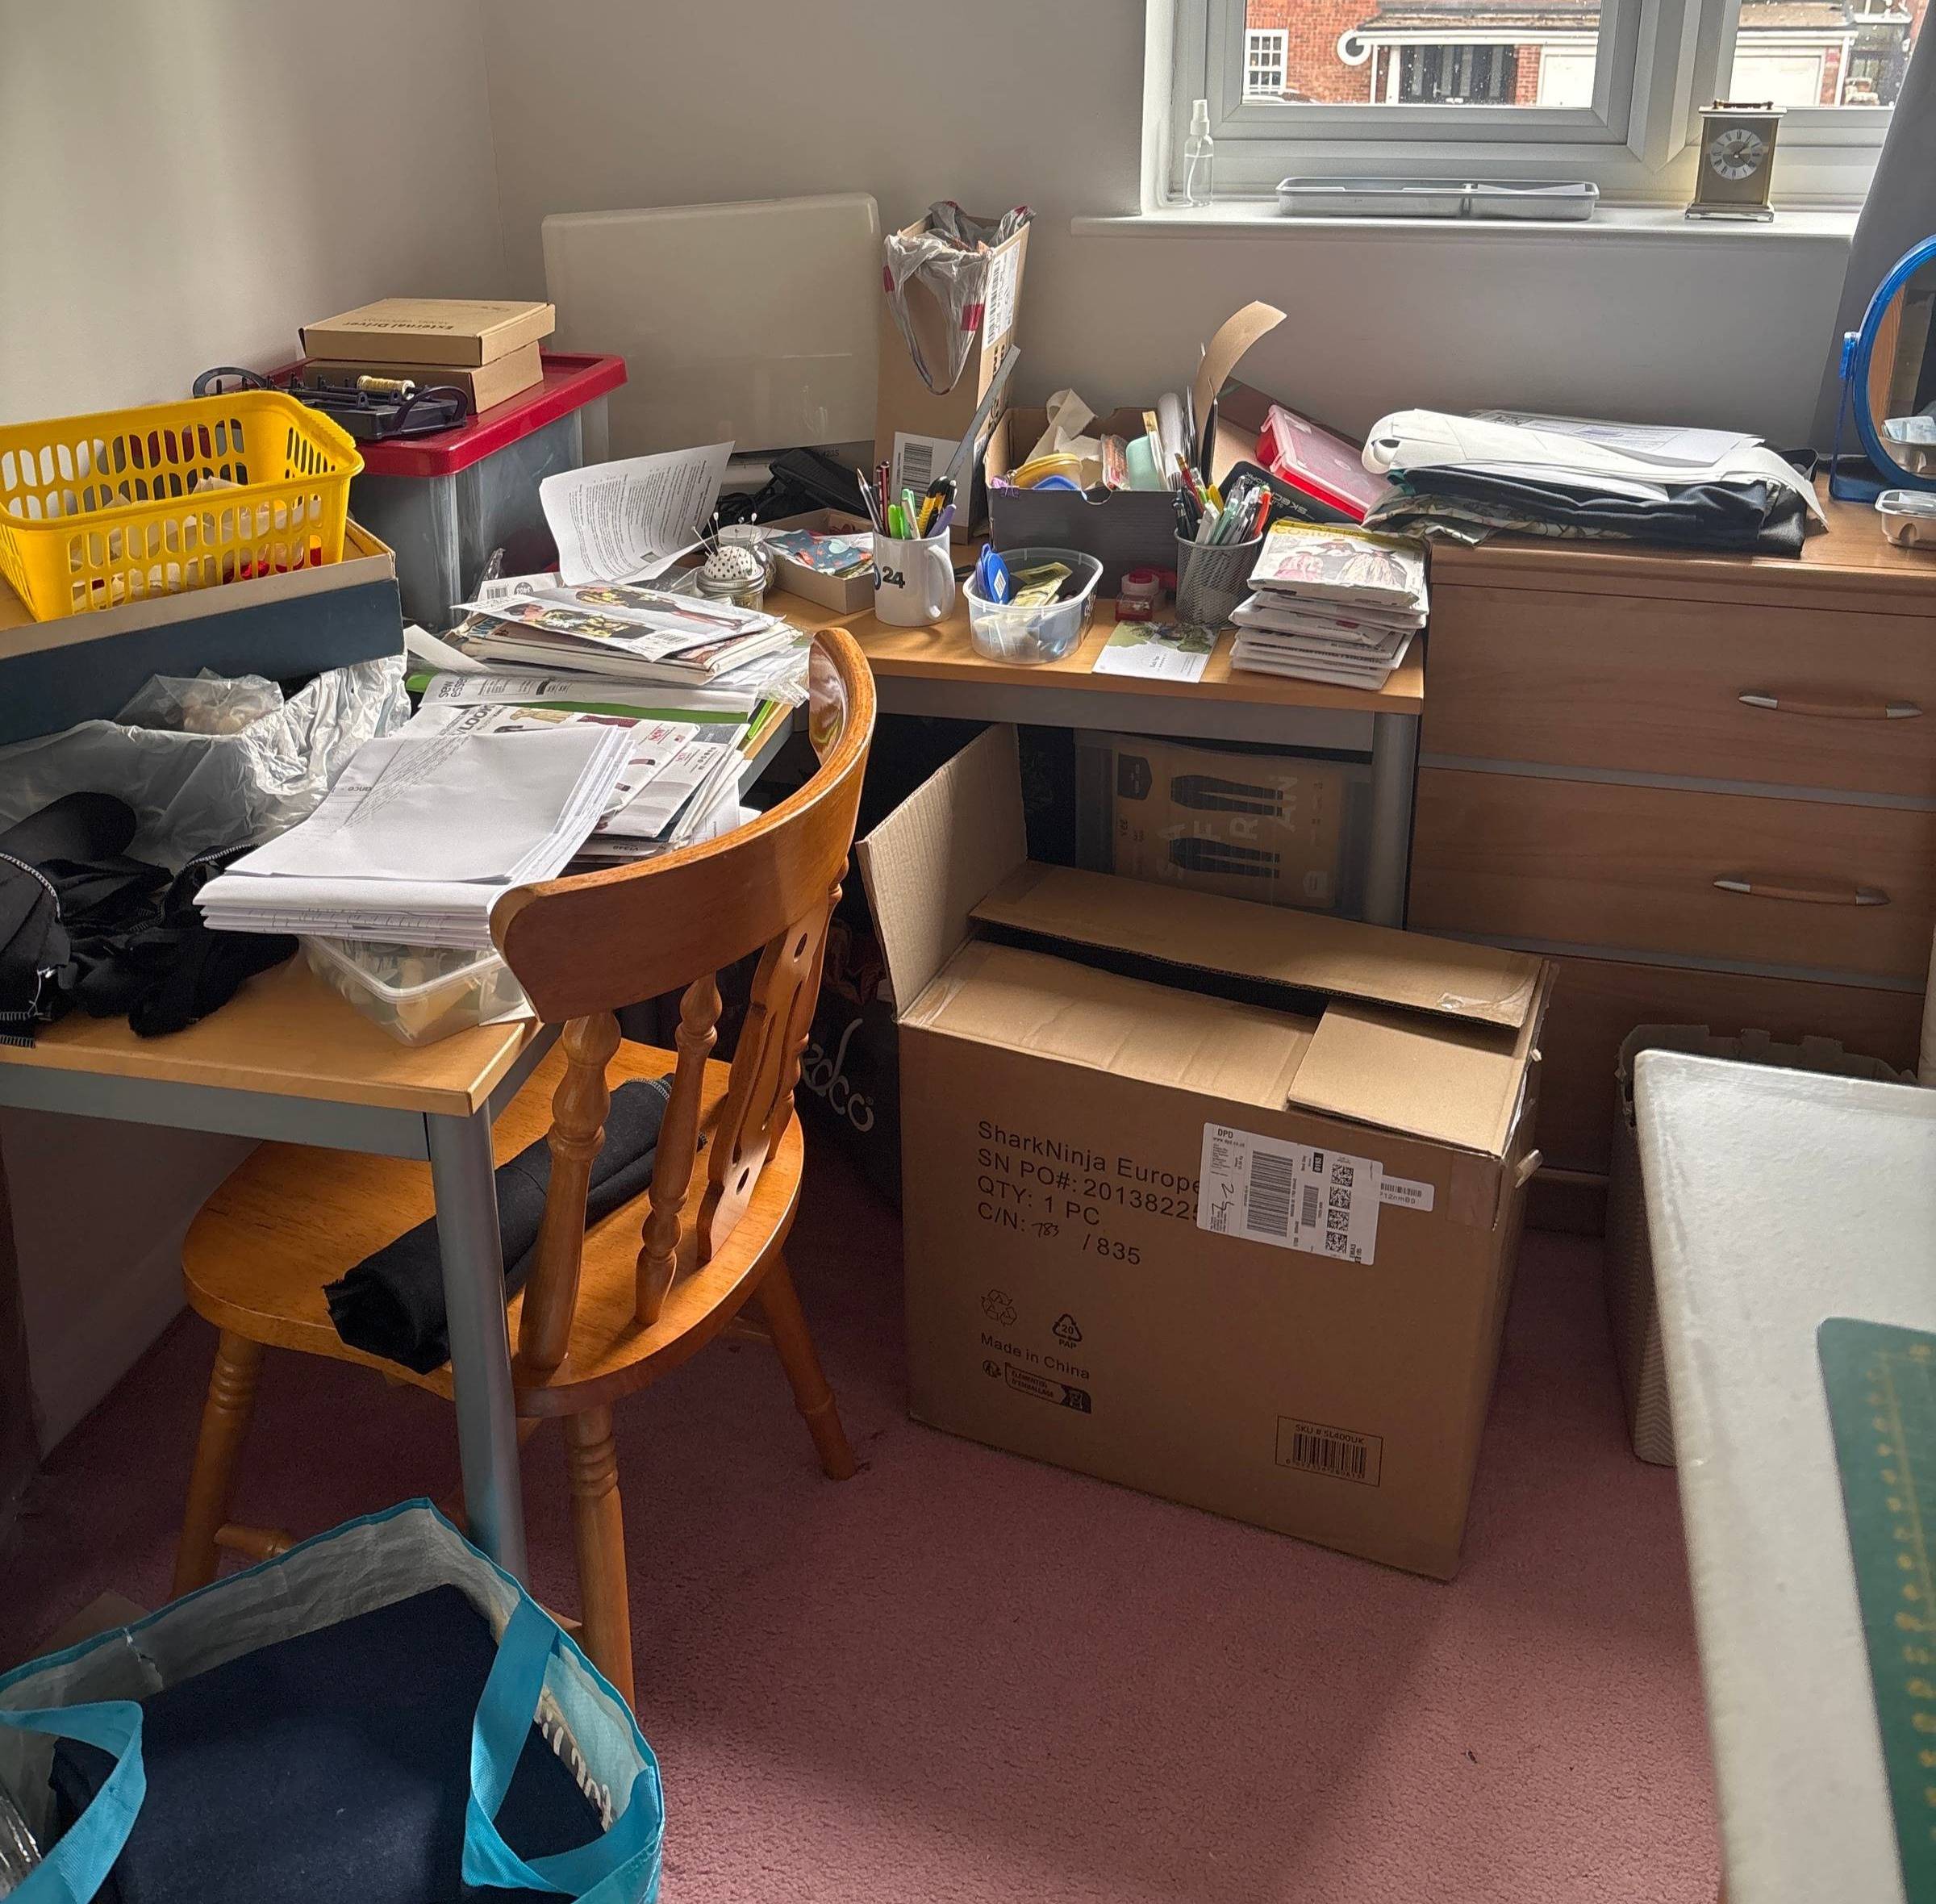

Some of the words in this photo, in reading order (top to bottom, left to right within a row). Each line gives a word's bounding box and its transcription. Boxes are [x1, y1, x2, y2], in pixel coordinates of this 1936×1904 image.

[342, 319, 392, 332] Driver
[402, 320, 455, 332] External
[1272, 492, 1308, 515] SKEC
[882, 567, 906, 589] 24
[438, 680, 453, 699] sew
[451, 674, 469, 699] esse
[1217, 1129, 1233, 1138] DPD
[977, 1120, 1107, 1173] SharkNinja
[1116, 1157, 1200, 1196] Europe
[977, 1148, 1011, 1174] SN
[1020, 1159, 1078, 1194] PO#:
[976, 1175, 1033, 1209] QTY:
[1045, 1196, 1054, 1213] 1
[1066, 1200, 1100, 1226] PC
[977, 1200, 1026, 1233] C/N:
[1061, 1323, 1074, 1335] 20
[1058, 1338, 1077, 1350] PAP
[980, 1332, 1022, 1358] Made
[1025, 1348, 1040, 1364] in
[1044, 1355, 1090, 1380] China
[1295, 1423, 1313, 1434] SKU
